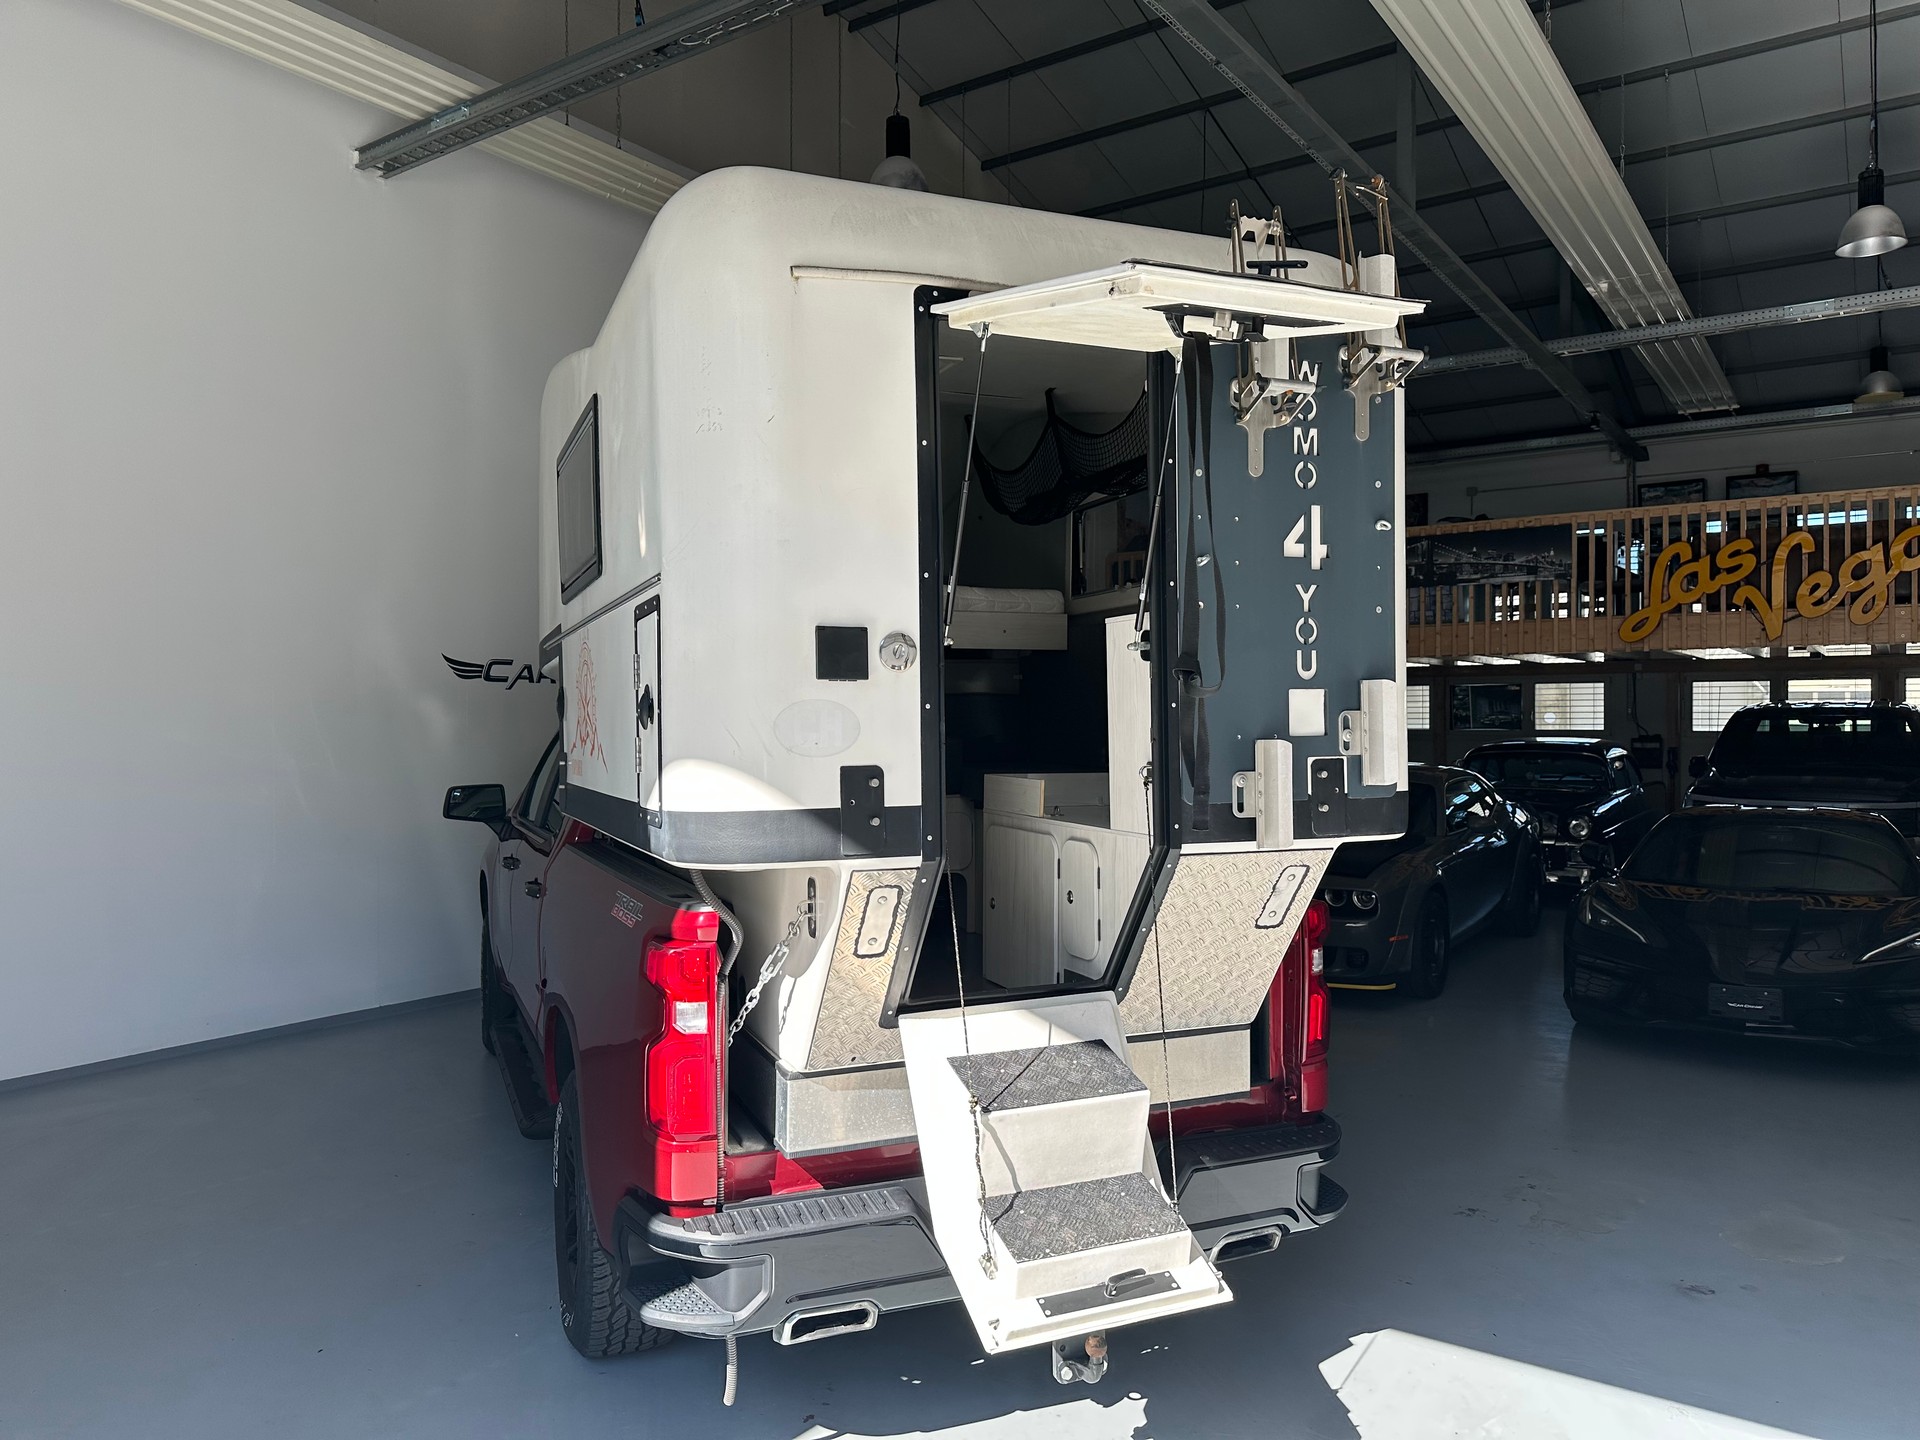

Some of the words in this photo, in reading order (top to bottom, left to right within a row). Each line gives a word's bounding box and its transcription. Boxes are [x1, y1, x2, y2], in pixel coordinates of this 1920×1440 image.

[1291, 359, 1318, 490] WOMO
[1283, 504, 1327, 571] 4
[1618, 538, 1757, 643] Las
[1294, 584, 1318, 681] YOU
[611, 903, 636, 928] BOSS
[616, 890, 643, 921] TRAIL
